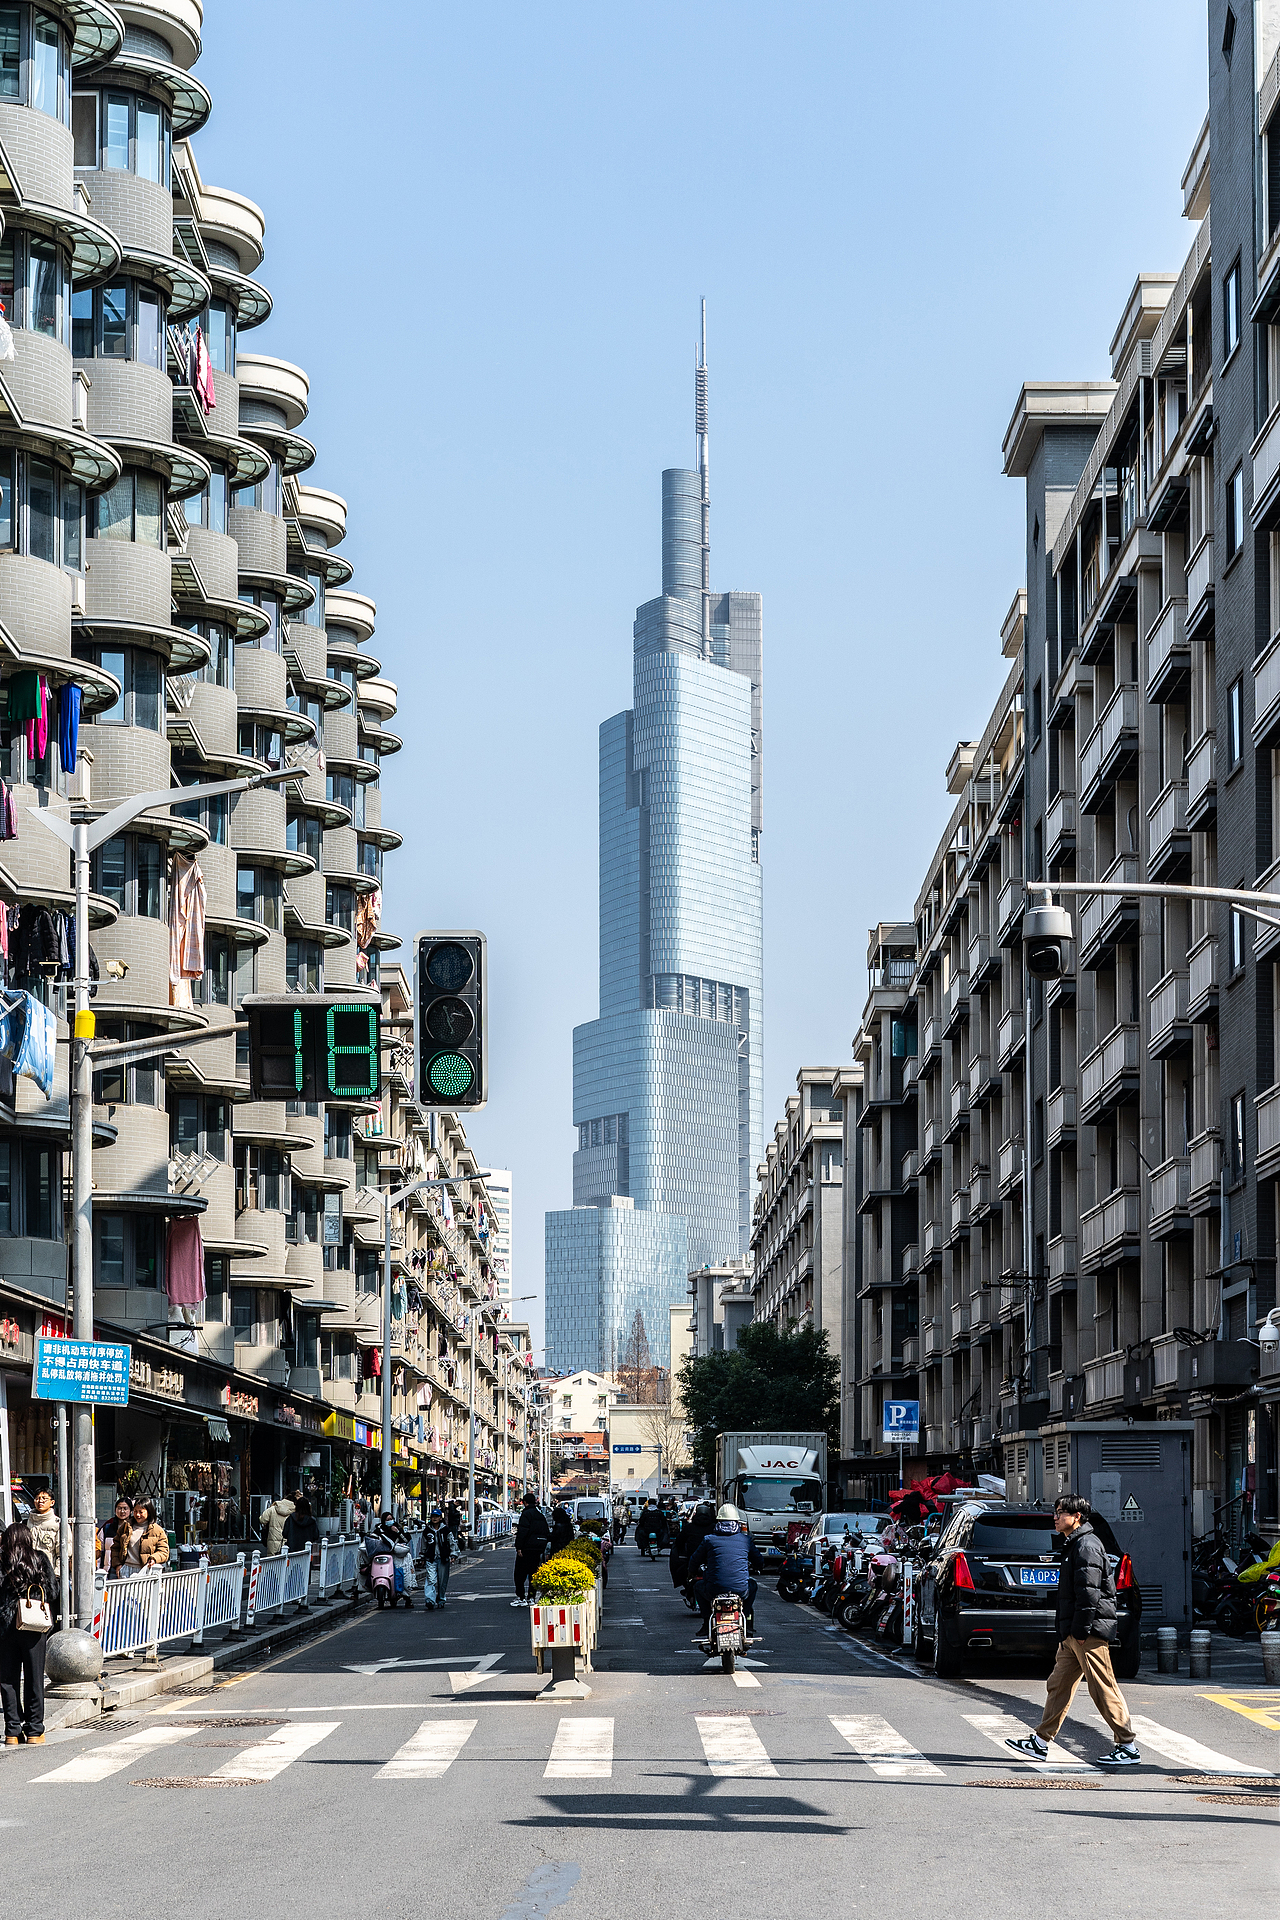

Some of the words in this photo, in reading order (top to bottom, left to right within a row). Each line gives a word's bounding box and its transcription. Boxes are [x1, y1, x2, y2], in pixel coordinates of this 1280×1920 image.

[294, 1004, 378, 1096] 18
[43, 1343, 127, 1359] 请非机动车有序停放，
[43, 1355, 127, 1372] 不得占用快车道，
[889, 1405, 907, 1427] P
[761, 1460, 799, 1468] JAC
[1023, 1570, 1057, 1582] 苏A·0P3
